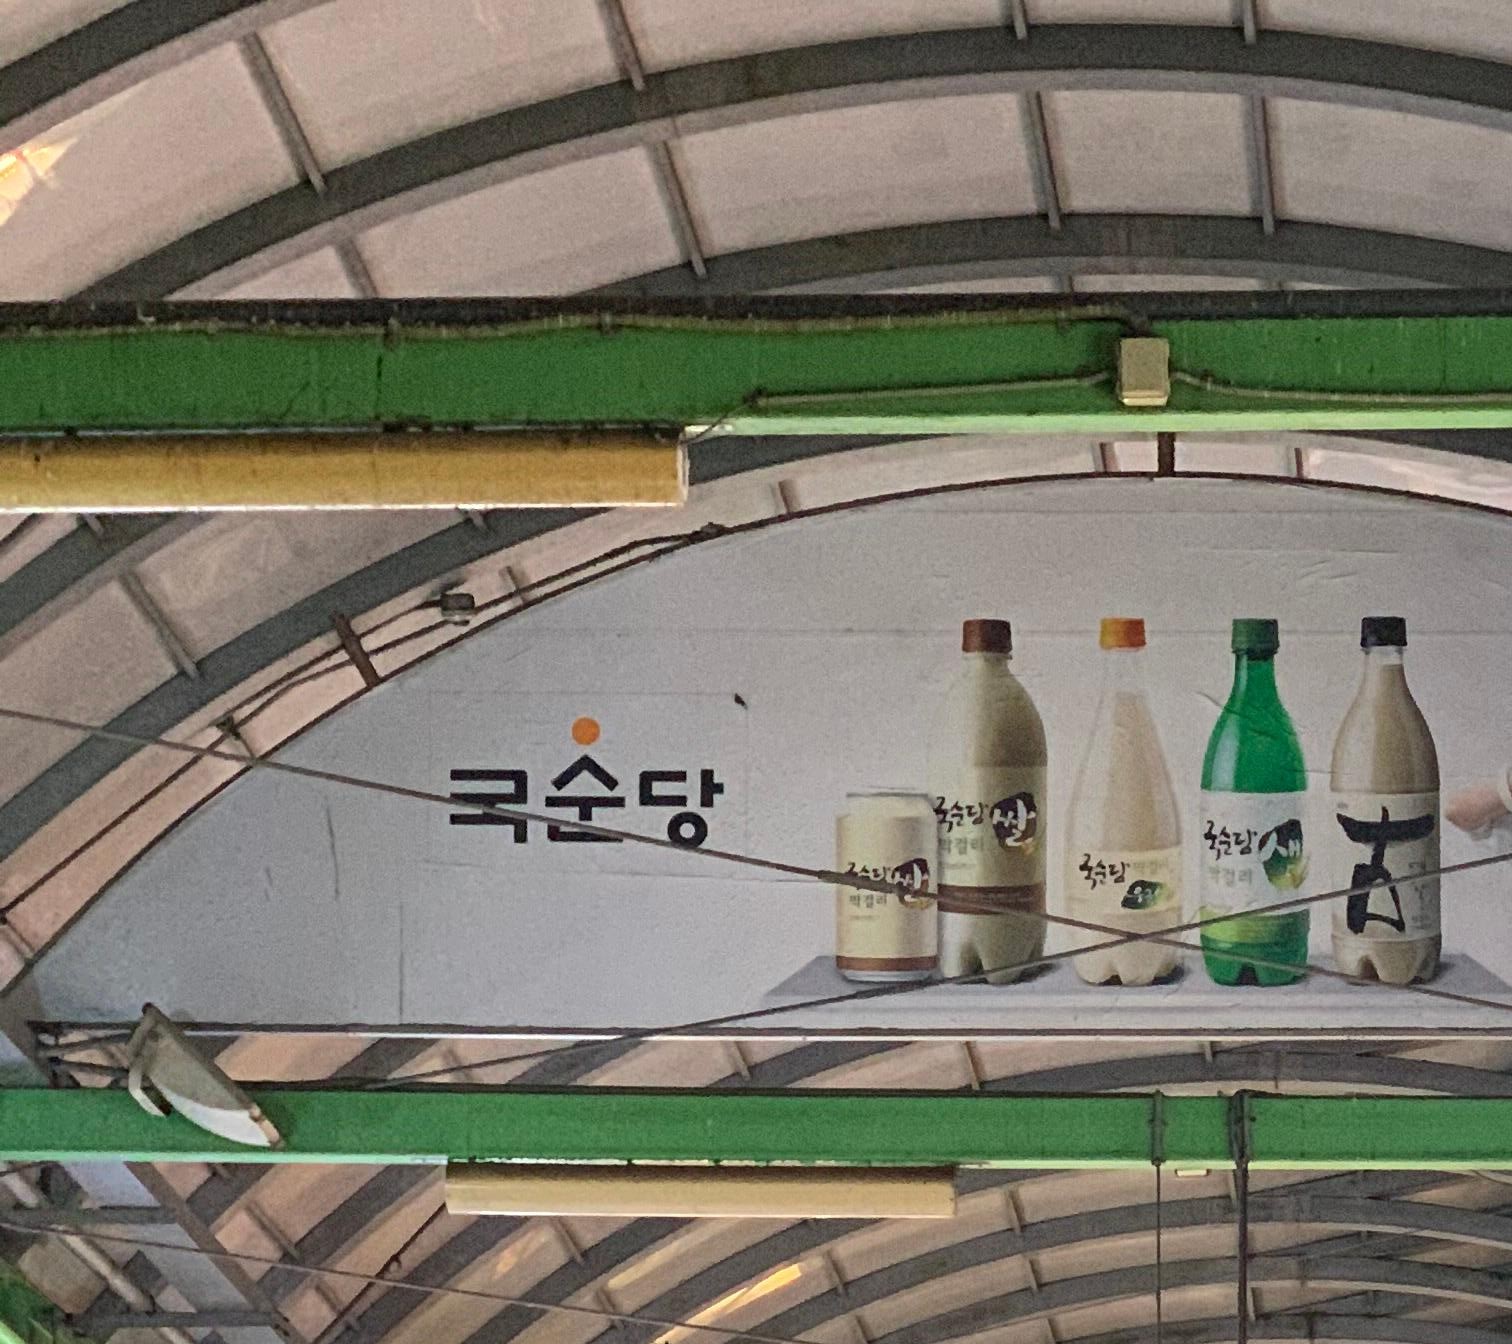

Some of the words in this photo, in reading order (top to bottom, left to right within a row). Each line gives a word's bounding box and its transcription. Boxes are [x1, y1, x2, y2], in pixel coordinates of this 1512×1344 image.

[449, 752, 725, 848] 국순당
[1204, 819, 1258, 861] 국순당
[1079, 853, 1131, 890] 국순당
